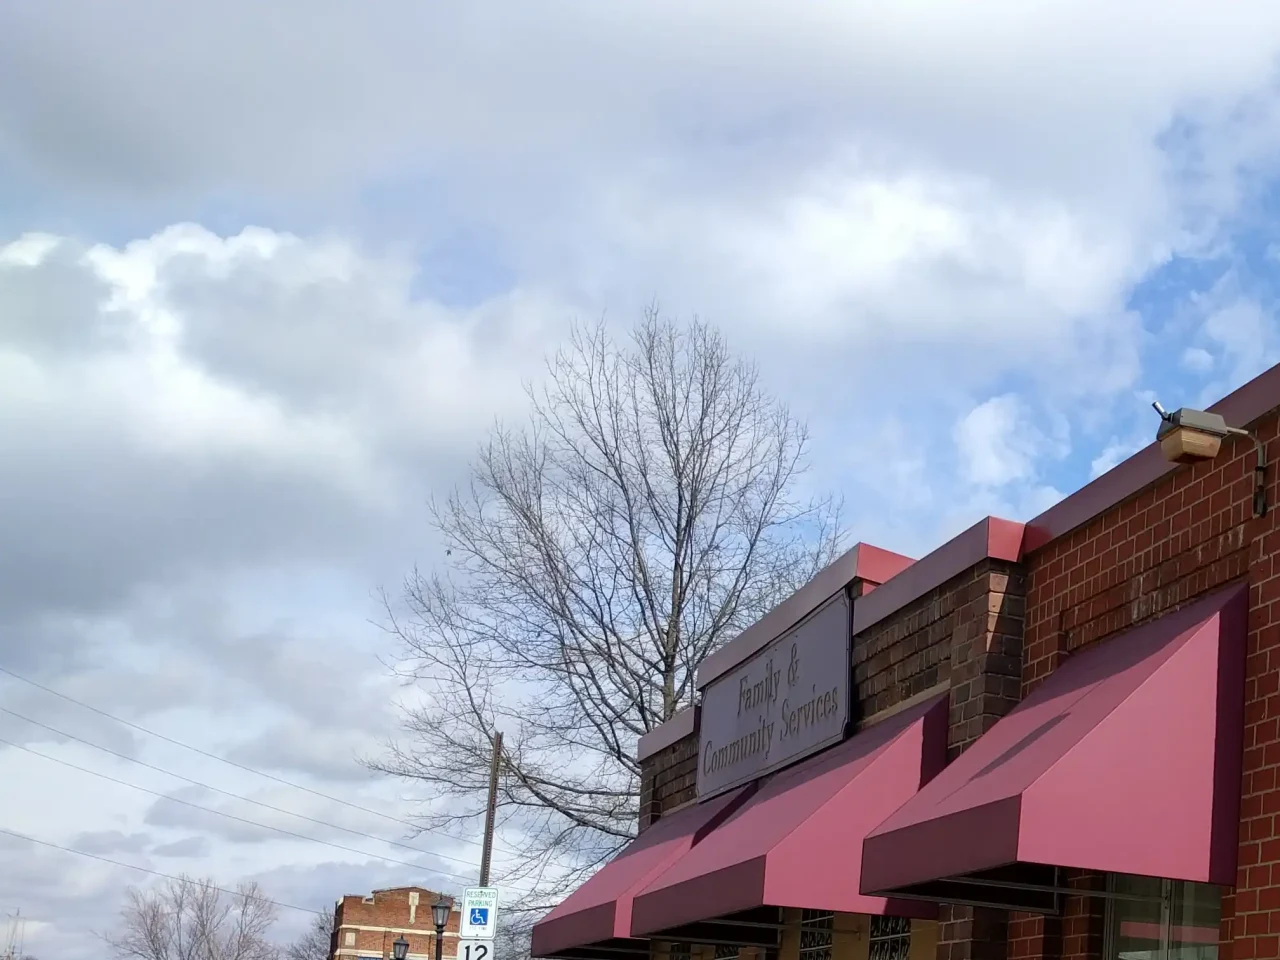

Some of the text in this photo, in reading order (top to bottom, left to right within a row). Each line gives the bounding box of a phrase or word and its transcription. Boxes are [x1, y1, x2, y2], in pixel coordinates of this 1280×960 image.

[737, 642, 801, 719] Family &
[702, 683, 839, 778] Community Services
[466, 890, 497, 899] RESERVED
